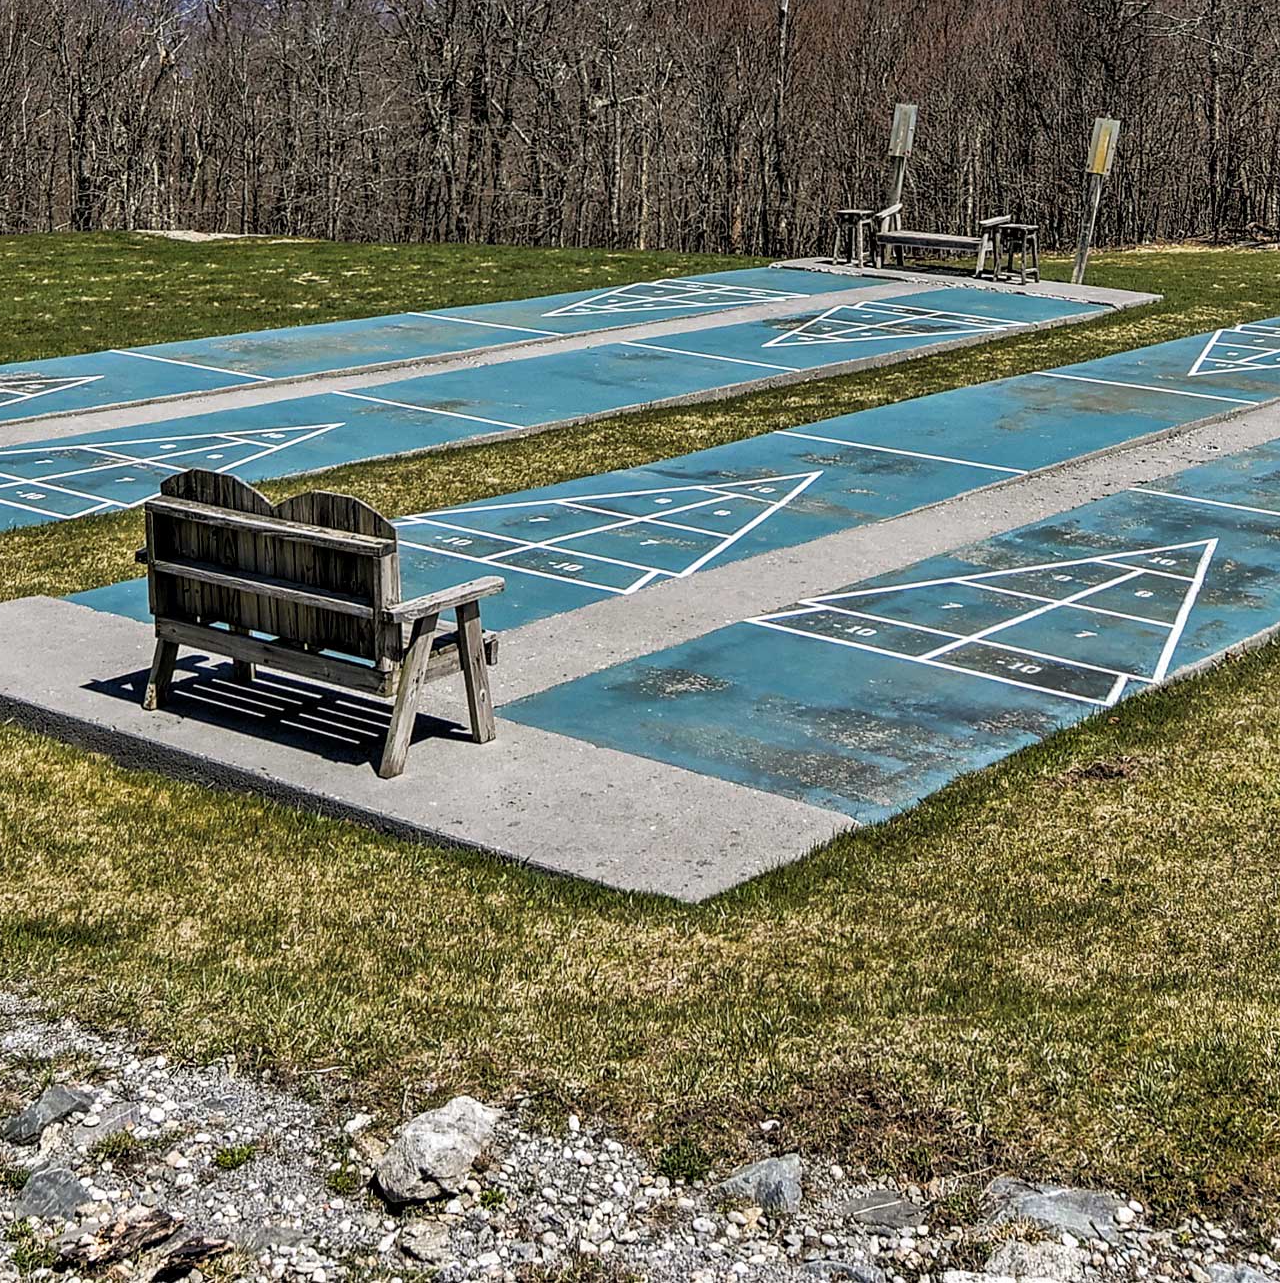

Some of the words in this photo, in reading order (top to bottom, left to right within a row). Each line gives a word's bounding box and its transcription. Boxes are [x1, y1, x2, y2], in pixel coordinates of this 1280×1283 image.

[748, 485, 776, 494] 10
[434, 535, 473, 546] -10
[548, 561, 584, 572] -10
[1148, 556, 1177, 566] 10
[833, 623, 878, 637] -10
[996, 660, 1043, 674] -10
